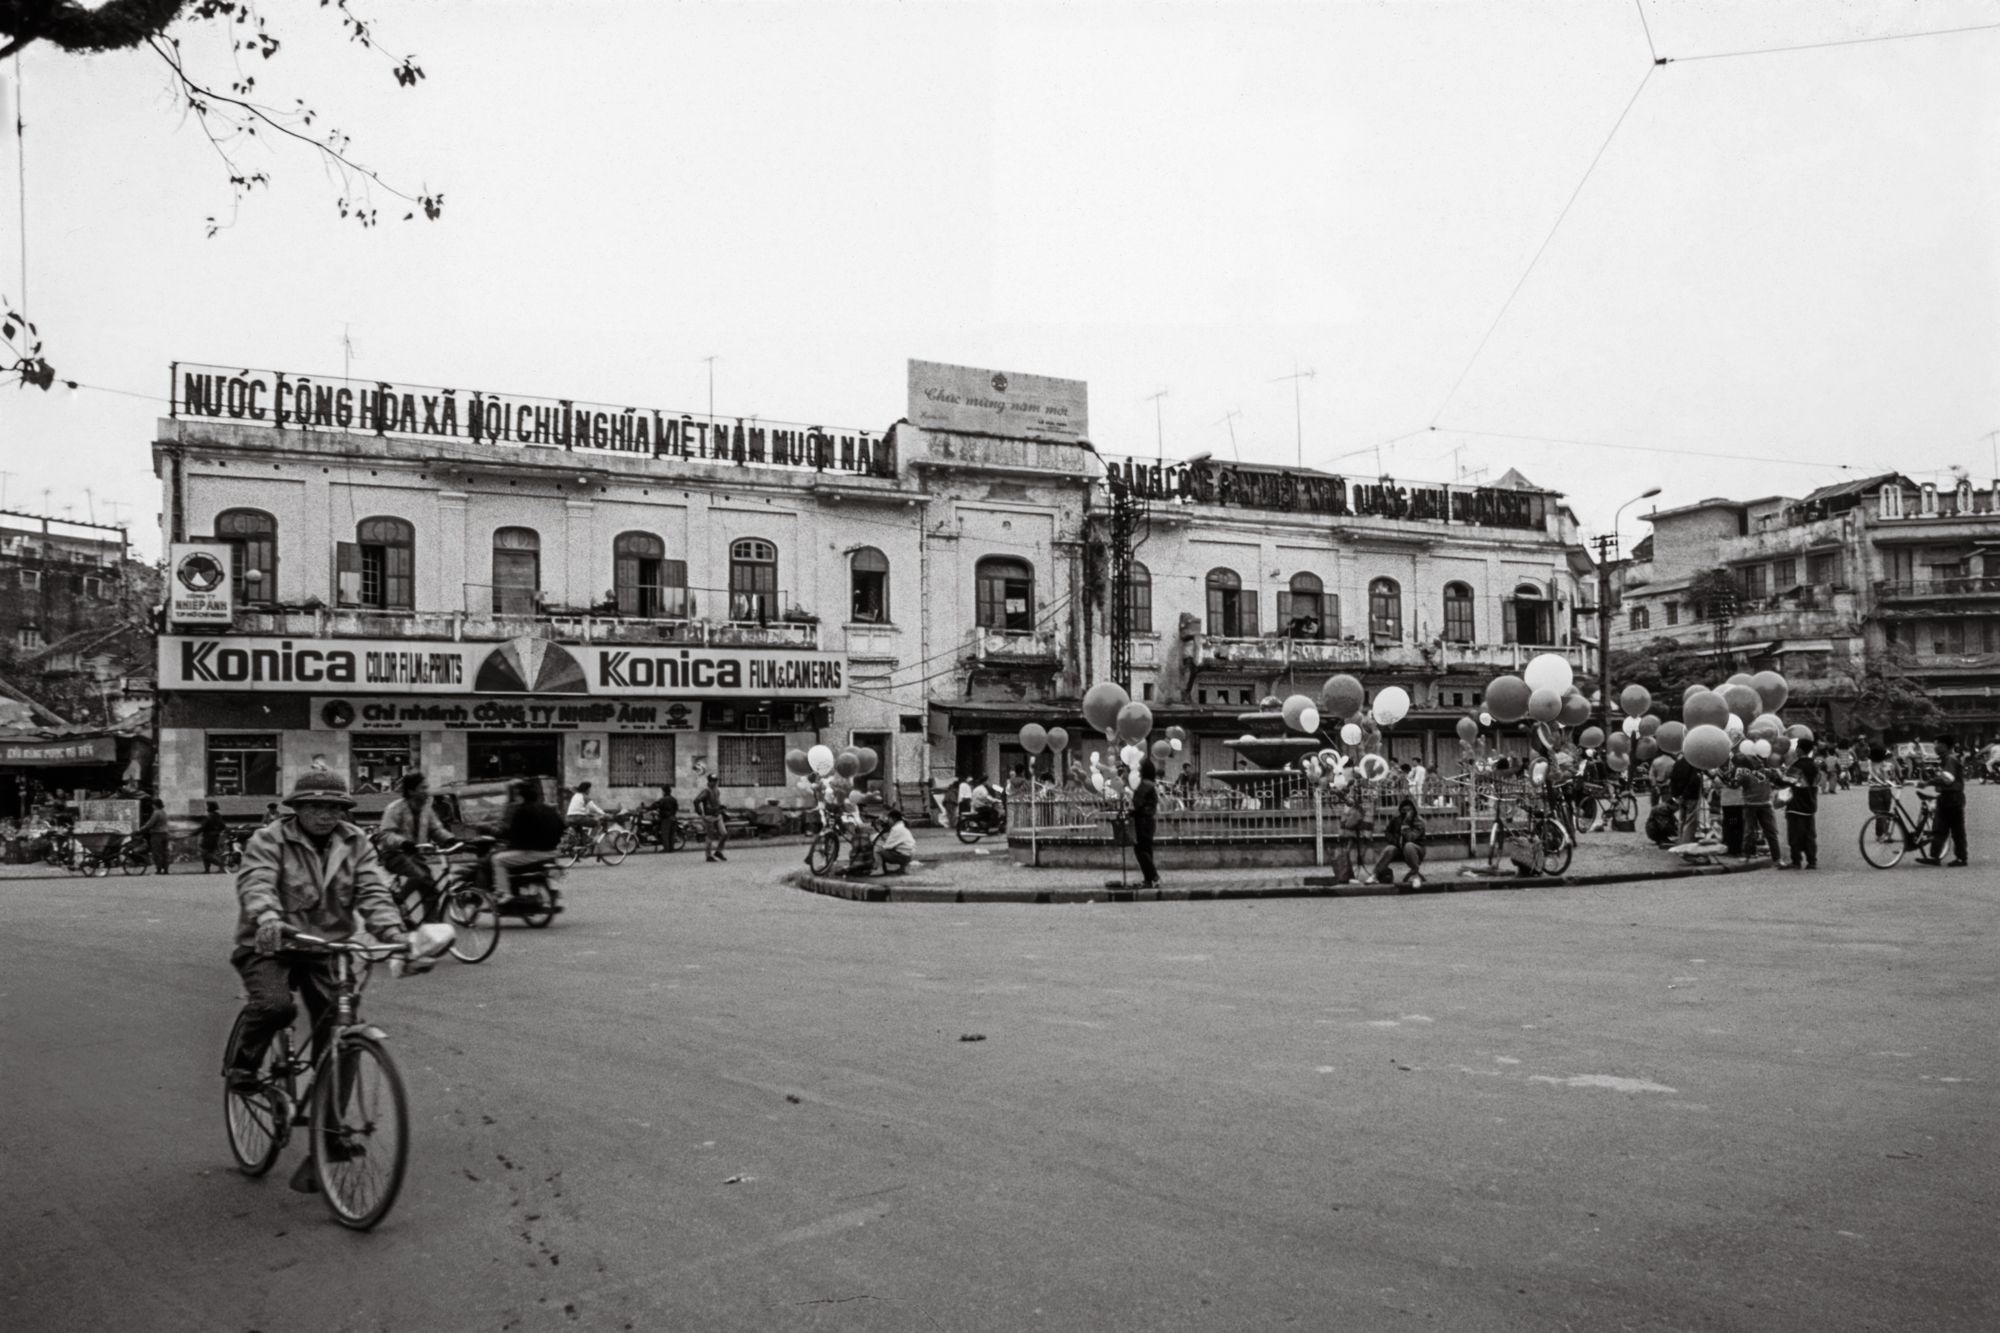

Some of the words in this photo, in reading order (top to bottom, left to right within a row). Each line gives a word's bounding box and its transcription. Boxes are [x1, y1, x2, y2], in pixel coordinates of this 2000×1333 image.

[185, 369, 267, 419] NƯỚC
[422, 389, 457, 436] XÃ
[575, 408, 650, 453] NGHĨA
[714, 424, 765, 463] NAM
[181, 641, 356, 683] Konica
[366, 651, 397, 683] COLOR
[599, 650, 742, 688] Konica
[528, 705, 558, 722] TY
